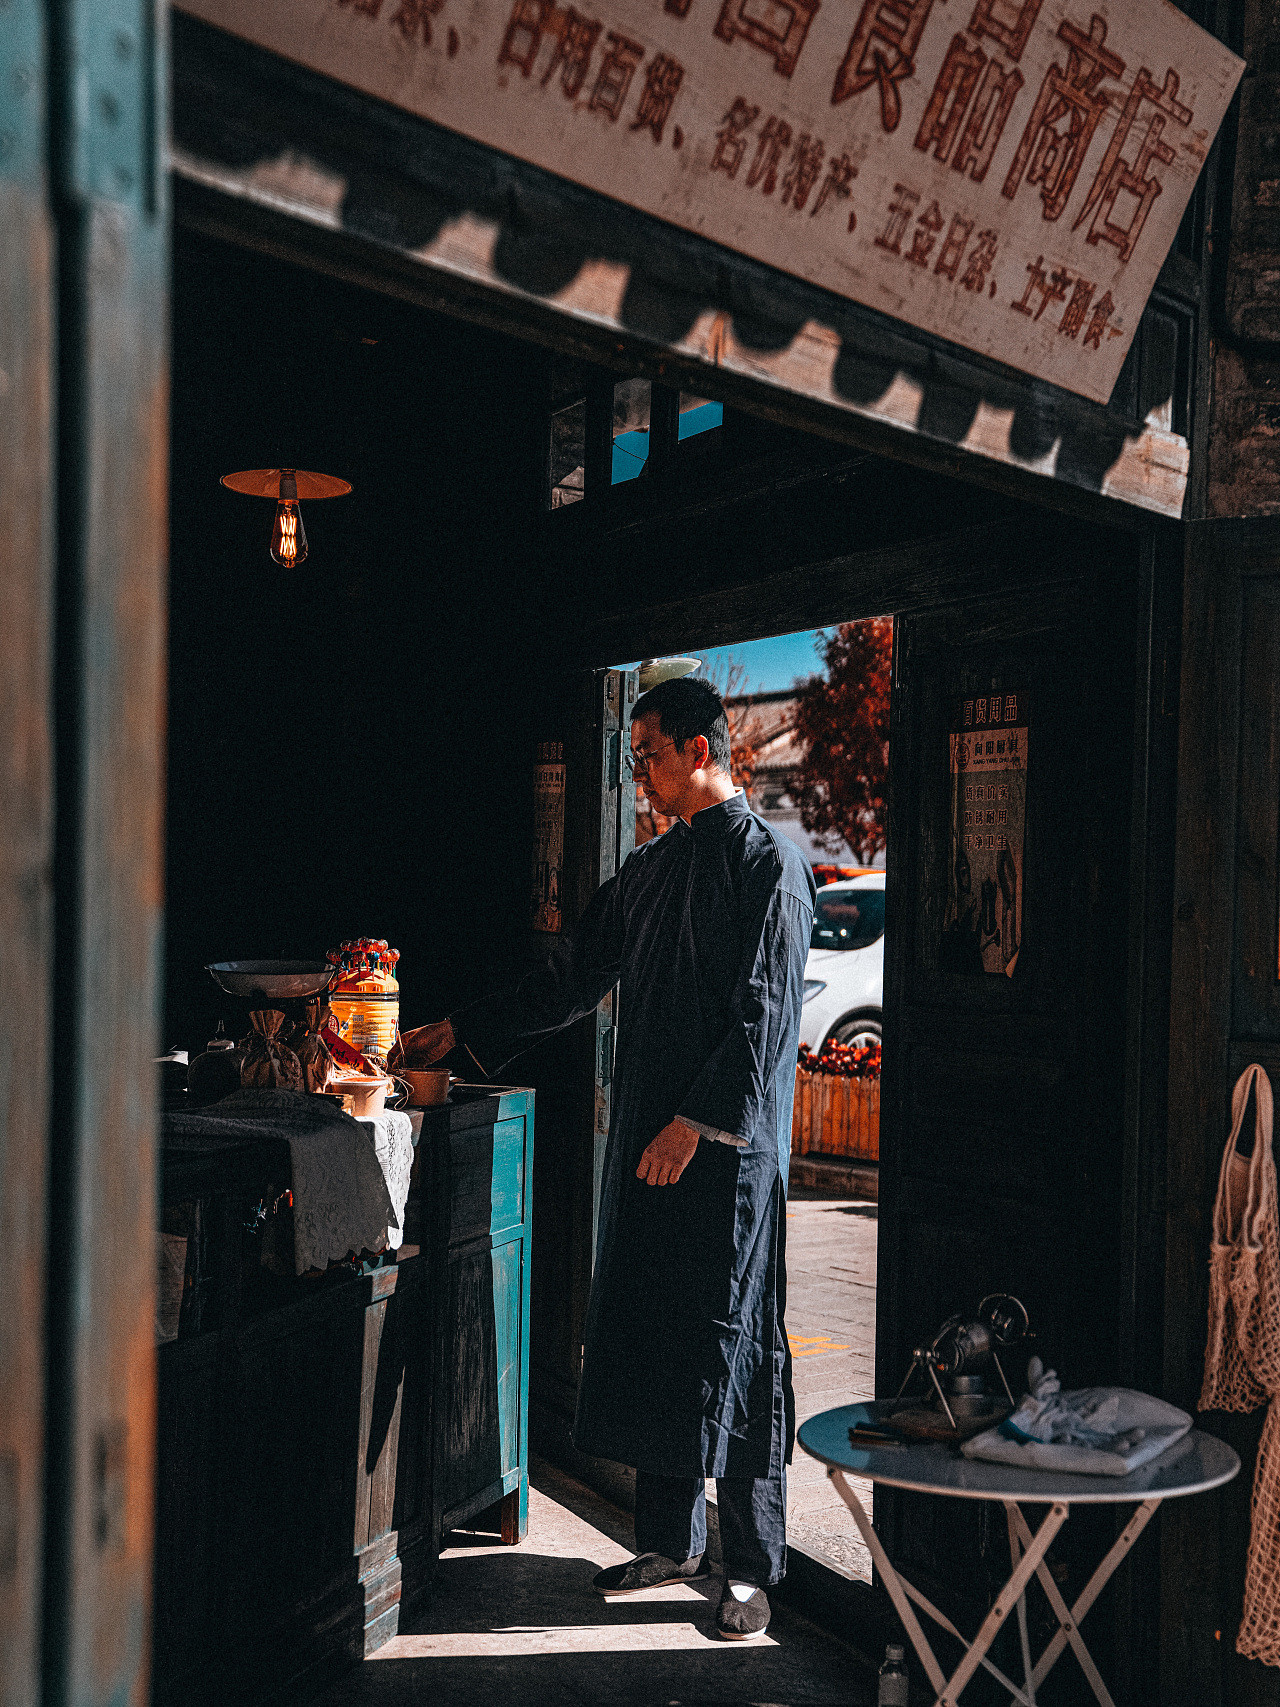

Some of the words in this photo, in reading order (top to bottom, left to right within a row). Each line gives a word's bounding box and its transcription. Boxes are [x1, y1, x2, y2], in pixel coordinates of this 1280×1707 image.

[663, 0, 1193, 263] 食品商店
[963, 694, 1018, 726] 百货用品
[975, 739, 1018, 756] 向阳厨具
[965, 784, 1008, 801] 货真价实
[965, 809, 1008, 826] 防锈耐用
[965, 834, 1007, 851] 干净卫生
